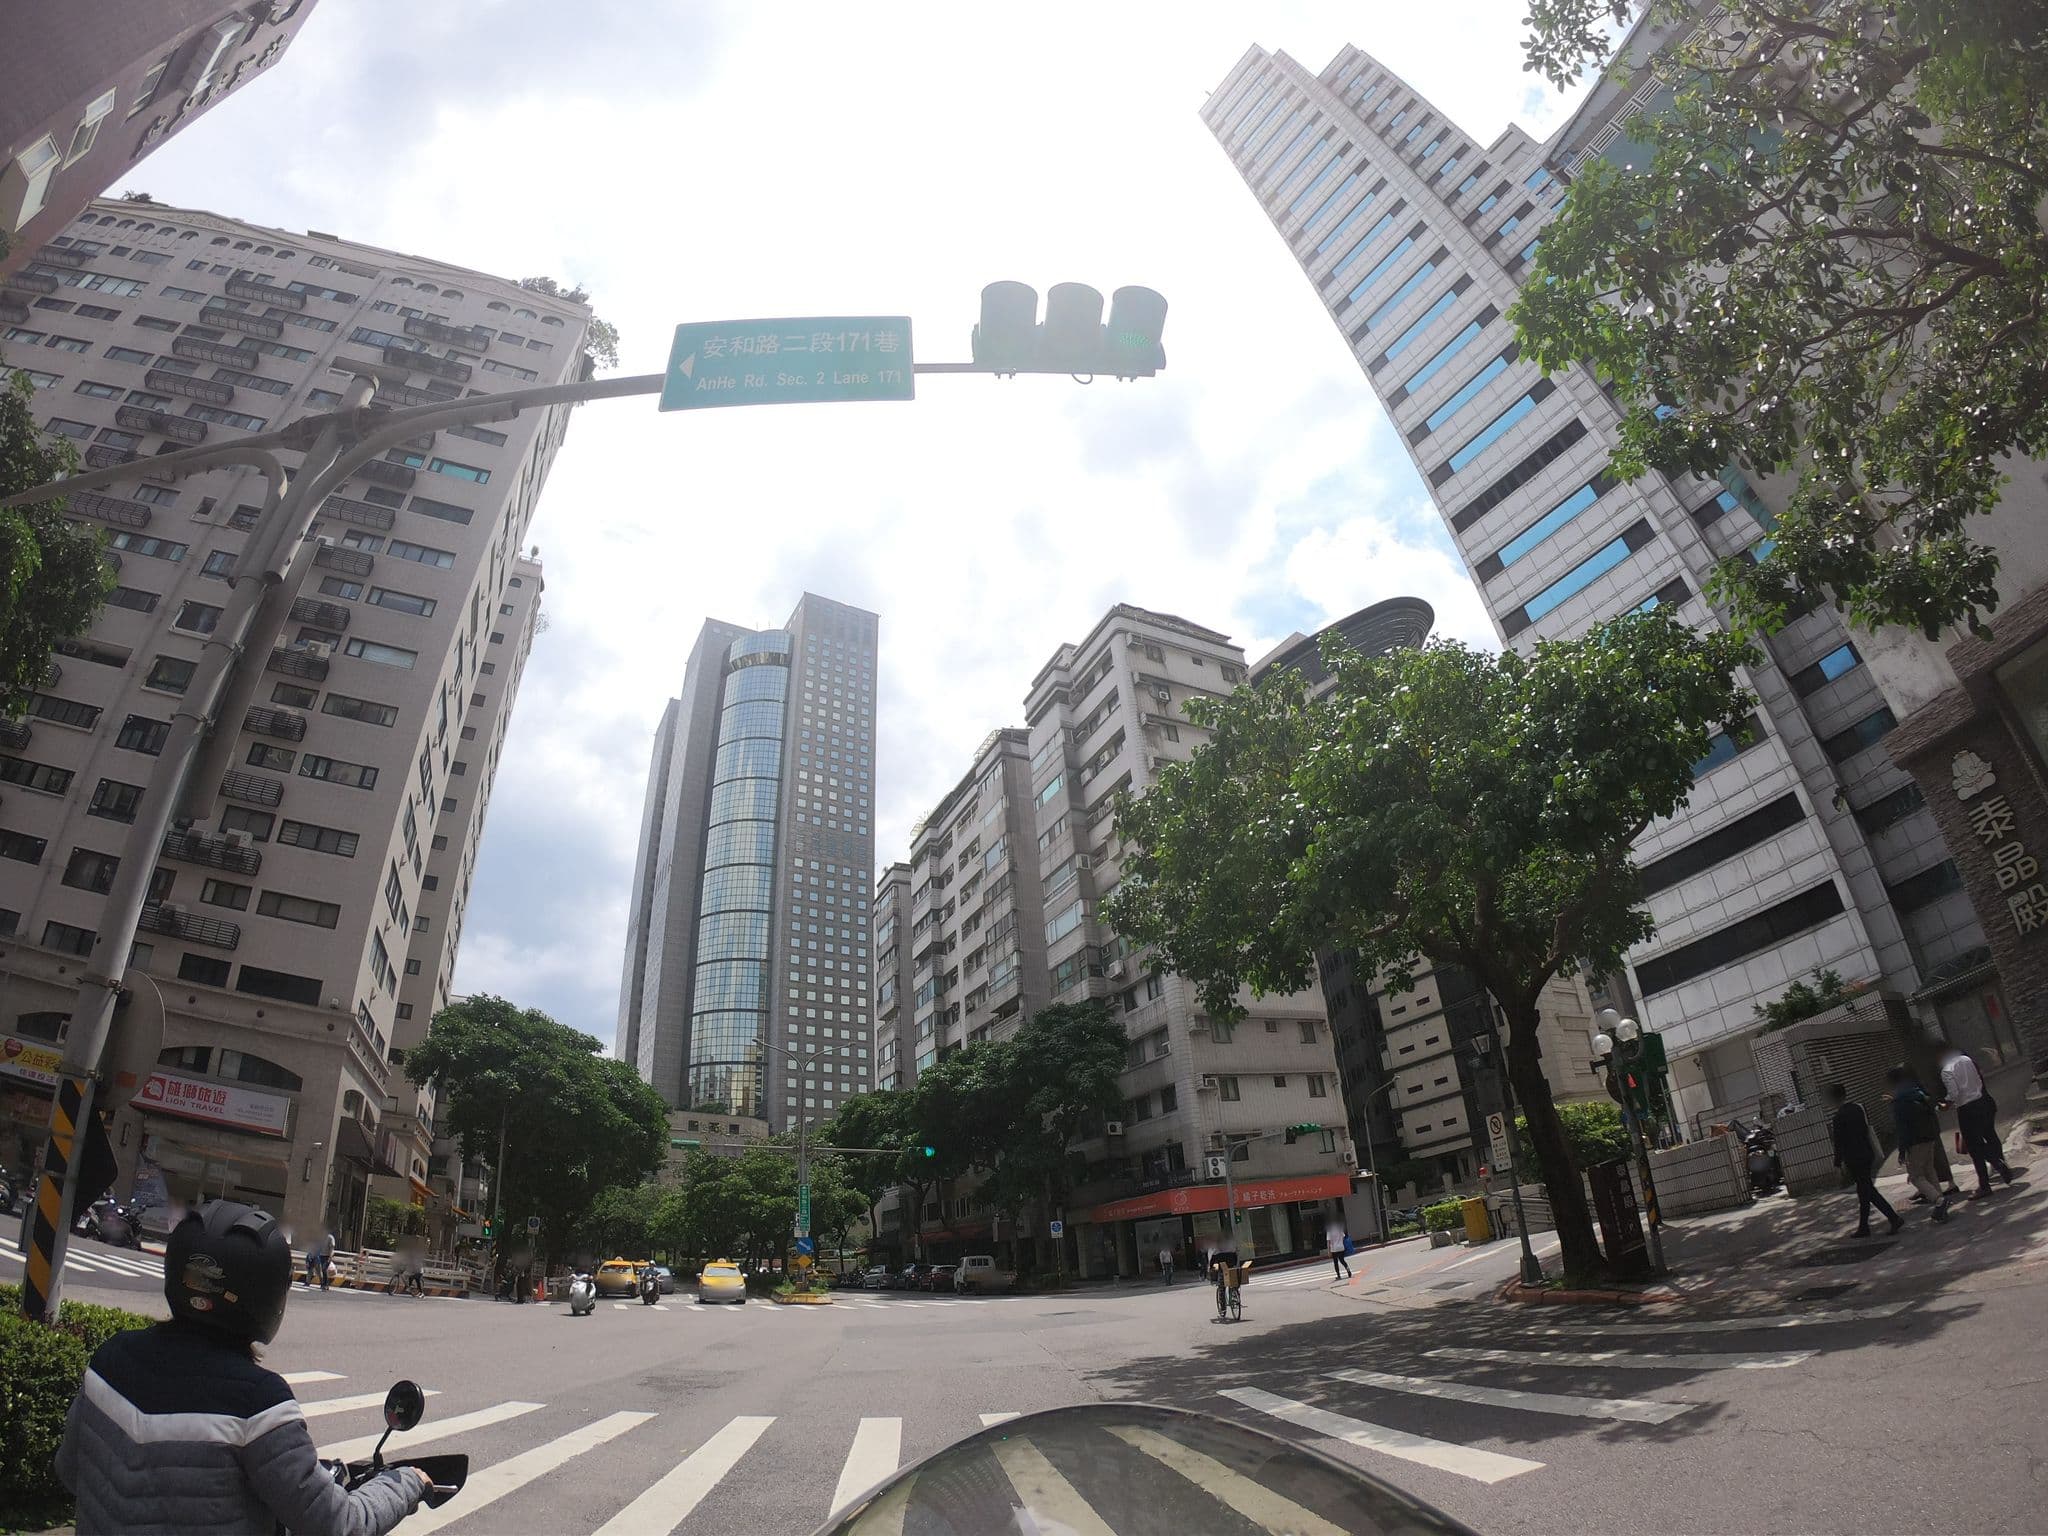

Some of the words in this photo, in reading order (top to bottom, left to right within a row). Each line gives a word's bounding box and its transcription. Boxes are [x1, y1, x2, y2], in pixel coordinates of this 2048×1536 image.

[703, 330, 899, 359] 安和路二段171巷
[696, 375, 736, 391] AnHe
[744, 374, 768, 388] Rd.
[776, 372, 808, 386] Sec.
[816, 371, 825, 385] 2
[833, 370, 868, 385] Lane
[879, 369, 903, 384] 171
[167, 1081, 227, 1105] 雄獅旅遊
[165, 1097, 186, 1107] LION
[190, 1102, 224, 1114] TRAVEL
